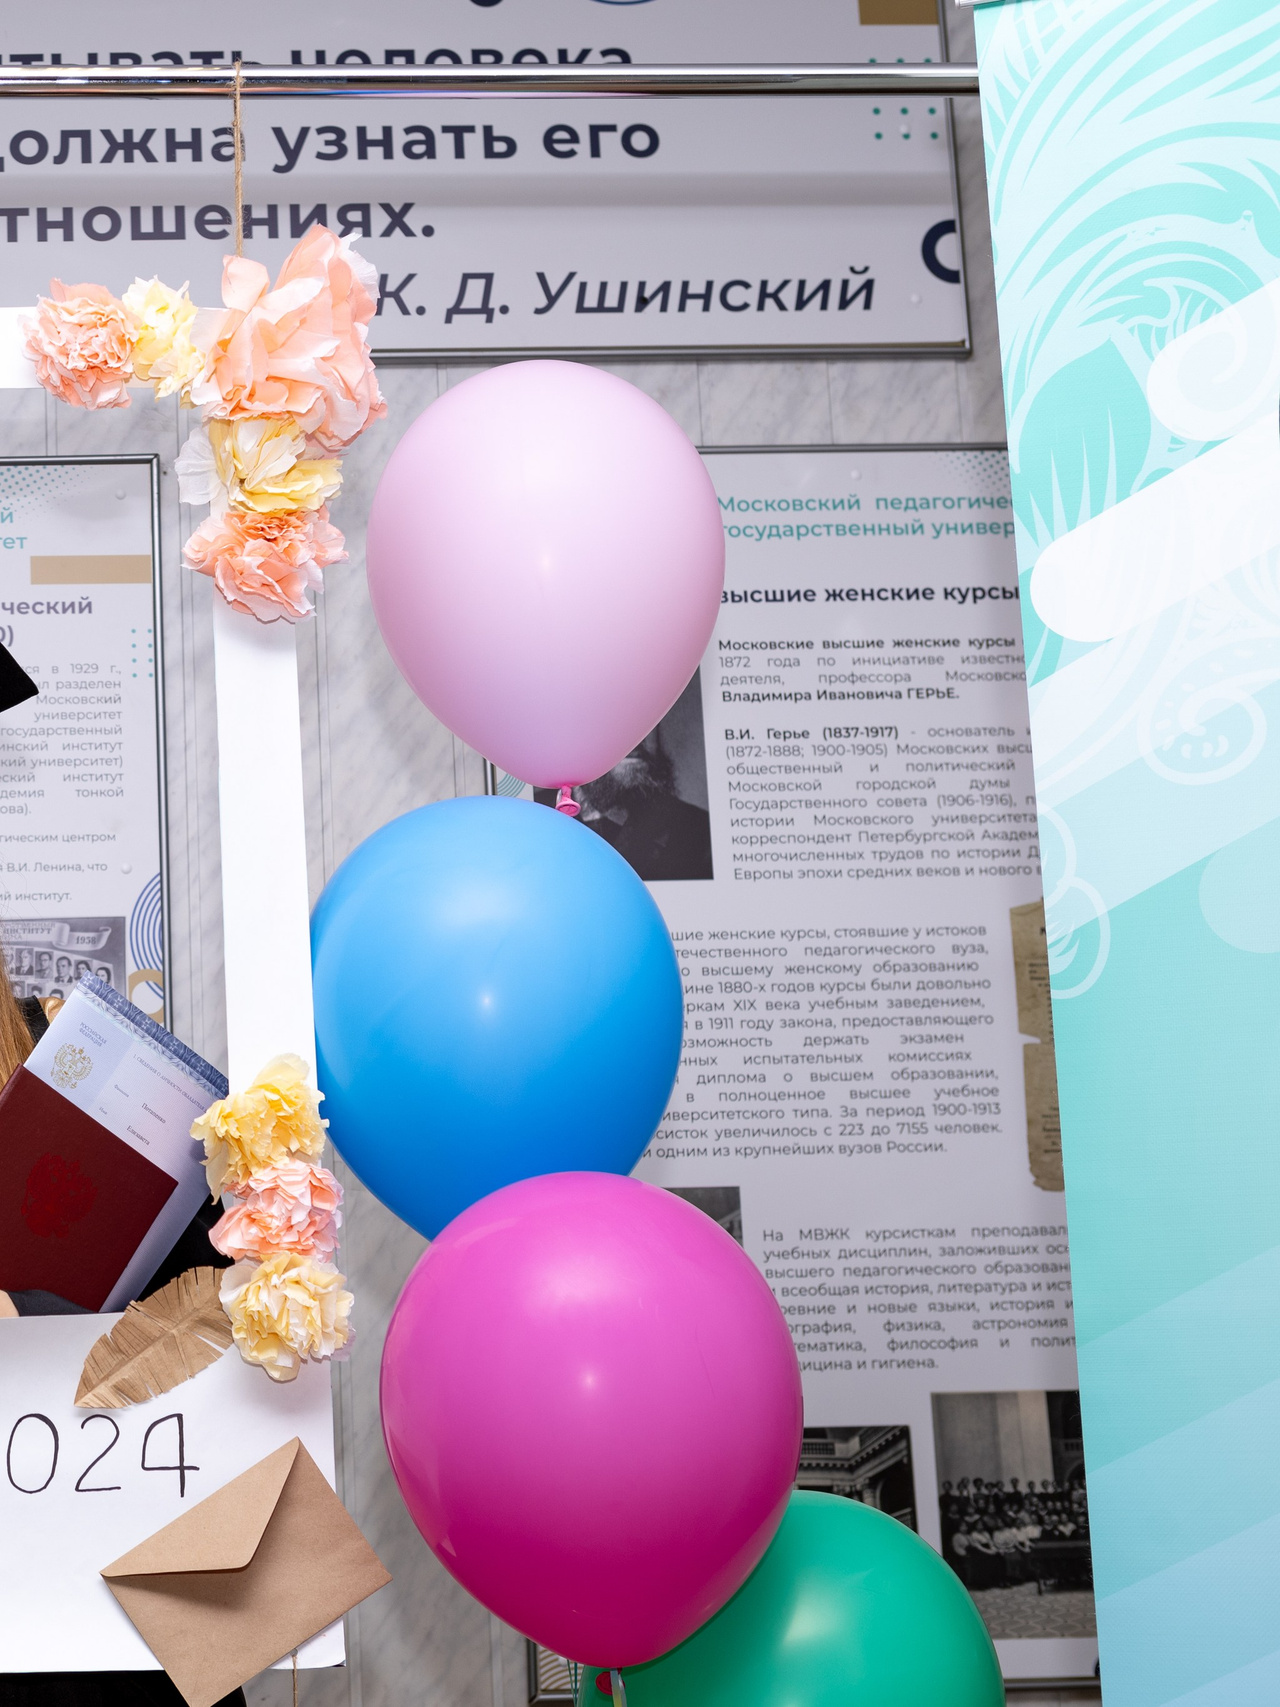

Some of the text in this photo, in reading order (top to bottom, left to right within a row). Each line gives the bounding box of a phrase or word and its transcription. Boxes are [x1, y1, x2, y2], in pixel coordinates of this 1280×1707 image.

[271, 125, 517, 173] узнать
[543, 124, 659, 159] его
[377, 266, 874, 324] К. Д. Ушинский
[718, 495, 1012, 512] Московский педагогиче
[932, 519, 1015, 537] универ
[825, 588, 934, 601] женские
[944, 585, 1018, 604] курсы
[719, 638, 1015, 650] Московские высшие женские курсы
[70, 663, 121, 674] 1929 г.,
[719, 656, 944, 668] 1872 года по инициативе
[720, 672, 911, 686] деятеля, профессора
[56, 681, 121, 691] разделен
[36, 694, 122, 704] Московский
[723, 688, 959, 703] Владимира Ивановича ГЕРЬЕ.
[34, 711, 122, 723] университет
[0, 725, 122, 738] государственный
[725, 726, 898, 741] В.И. Герье (1837-1917)
[63, 742, 123, 753] институт
[726, 743, 887, 760] (1872-1888; 1900-1905)
[30, 756, 123, 769] университет)
[727, 762, 842, 775] общественный
[63, 773, 124, 784] институт
[729, 778, 936, 792] Московской городской
[75, 787, 123, 797] тонкой
[730, 798, 927, 812] Государственного совета
[62, 834, 116, 843] центром
[7, 863, 30, 872] В.И.
[34, 862, 84, 872] Ленина,
[15, 893, 71, 902] институт.
[709, 929, 830, 941] женские курсы,
[805, 944, 988, 957] педагогического вуза,
[702, 964, 862, 977] высшему женскому
[718, 978, 911, 994] 1880-х годов курсы были
[734, 997, 878, 1012] XIX века учебным
[709, 1017, 836, 1031] 1911 году закона,
[697, 1072, 873, 1085] диплома высшем
[719, 1091, 825, 1102] полноценное
[792, 1102, 1001, 1119] типа. За период 1900-1913
[715, 1122, 928, 1141] увеличилось 223 до 7155
[735, 1141, 946, 1159] крупнейших вузов России.
[763, 1228, 955, 1242] На МВЖК курсисткам
[764, 1247, 931, 1263] учебных дисциплин,
[843, 1264, 976, 1278] педагогического
[871, 1358, 939, 1370] гигиена.
